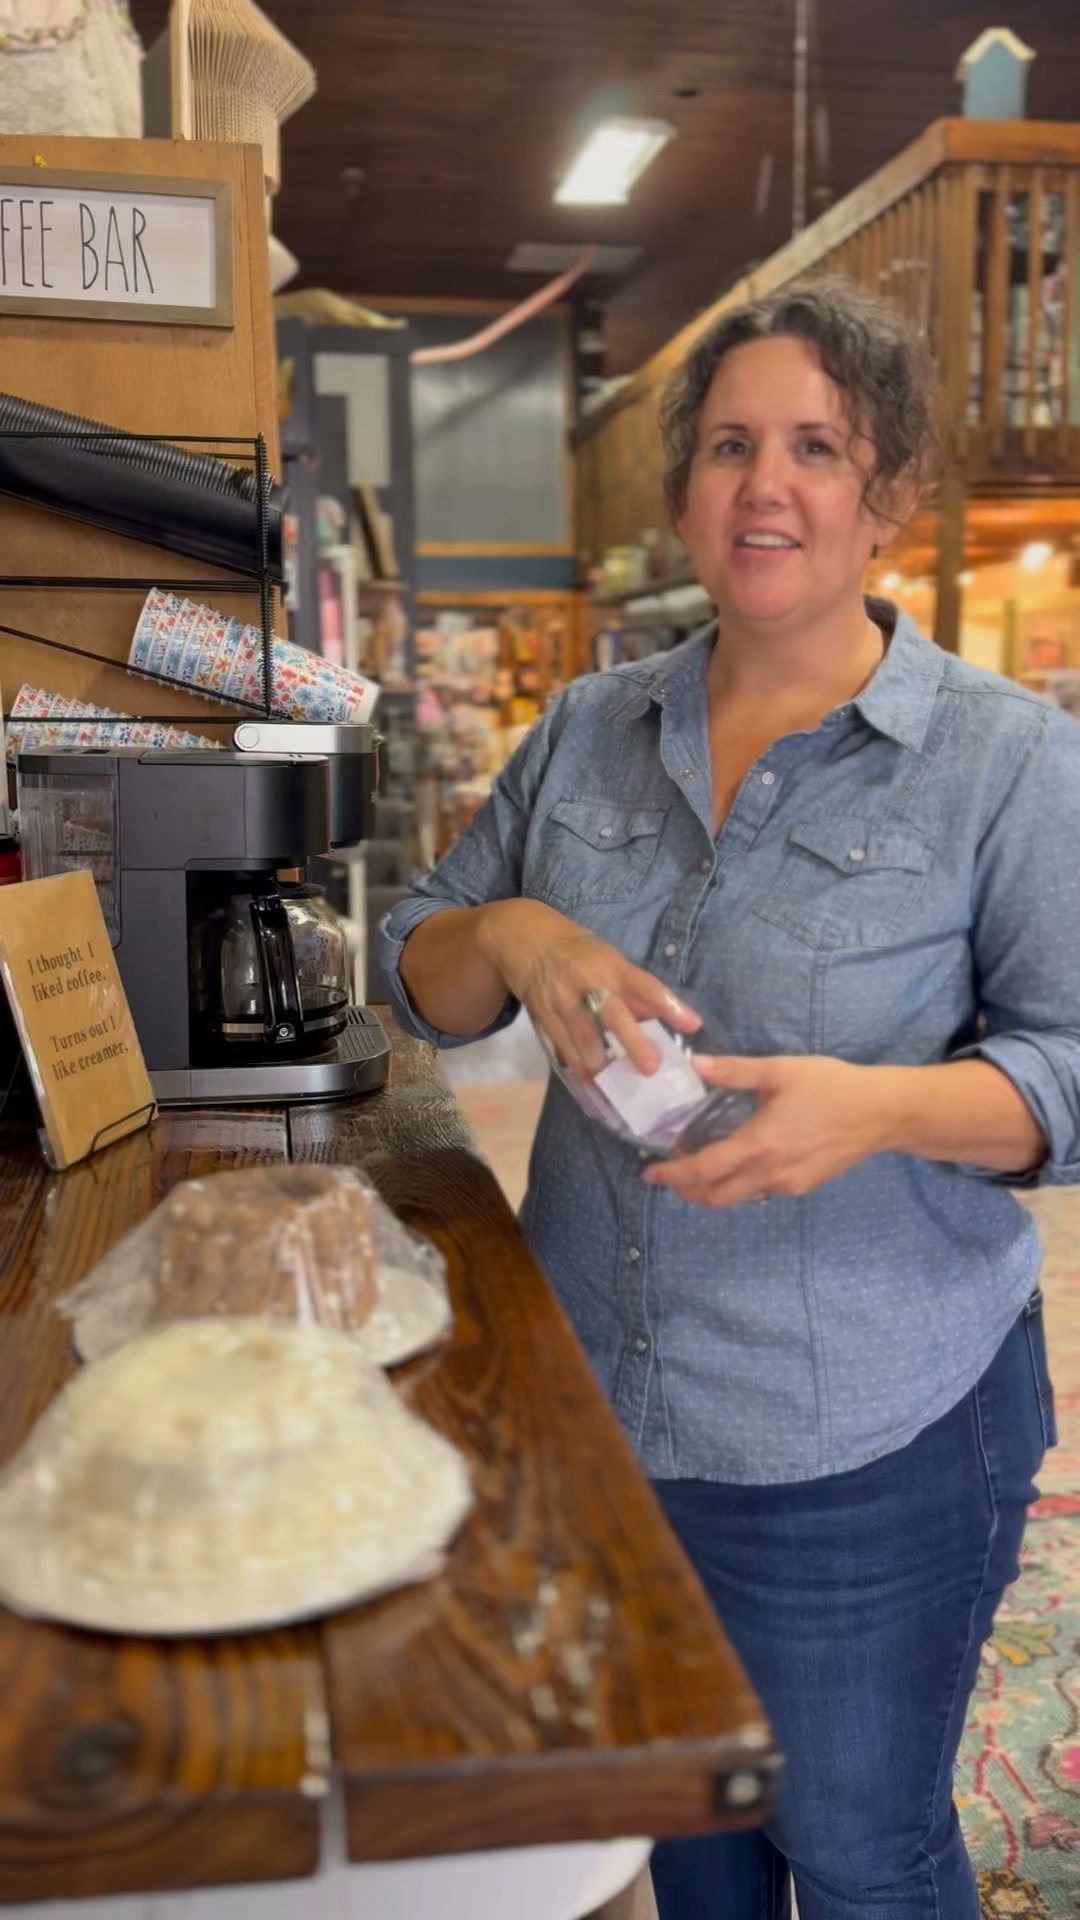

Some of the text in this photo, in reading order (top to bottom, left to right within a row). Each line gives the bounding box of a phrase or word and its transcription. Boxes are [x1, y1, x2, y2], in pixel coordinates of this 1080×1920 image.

[0, 198, 154, 294] FEE BAR
[28, 942, 94, 975] I thought I
[31, 968, 107, 1002] liked coffee.
[49, 1015, 116, 1053] Turns out I
[51, 1042, 129, 1082] like creamer.
